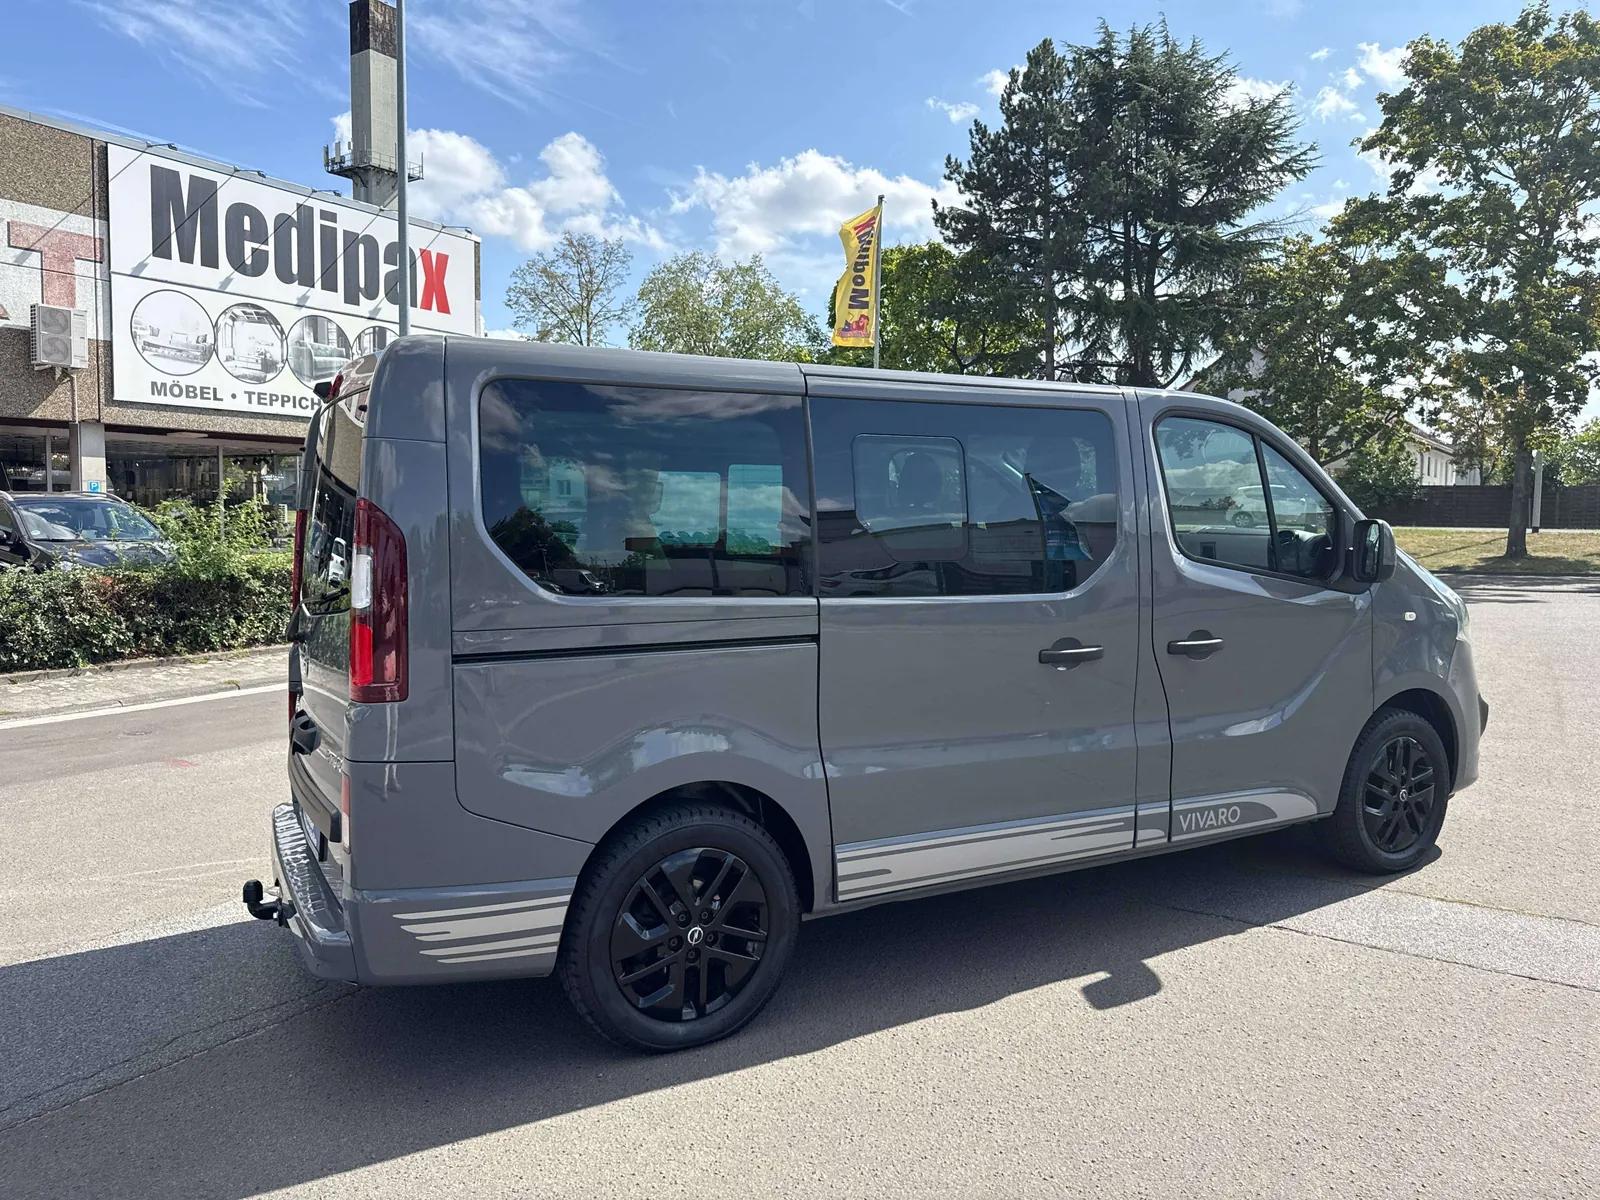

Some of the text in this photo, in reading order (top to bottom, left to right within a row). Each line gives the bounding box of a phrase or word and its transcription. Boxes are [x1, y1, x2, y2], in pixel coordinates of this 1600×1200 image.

[150, 164, 451, 315] Medipax
[150, 380, 224, 402] MÖBEL
[1179, 805, 1241, 832] VIVARO
